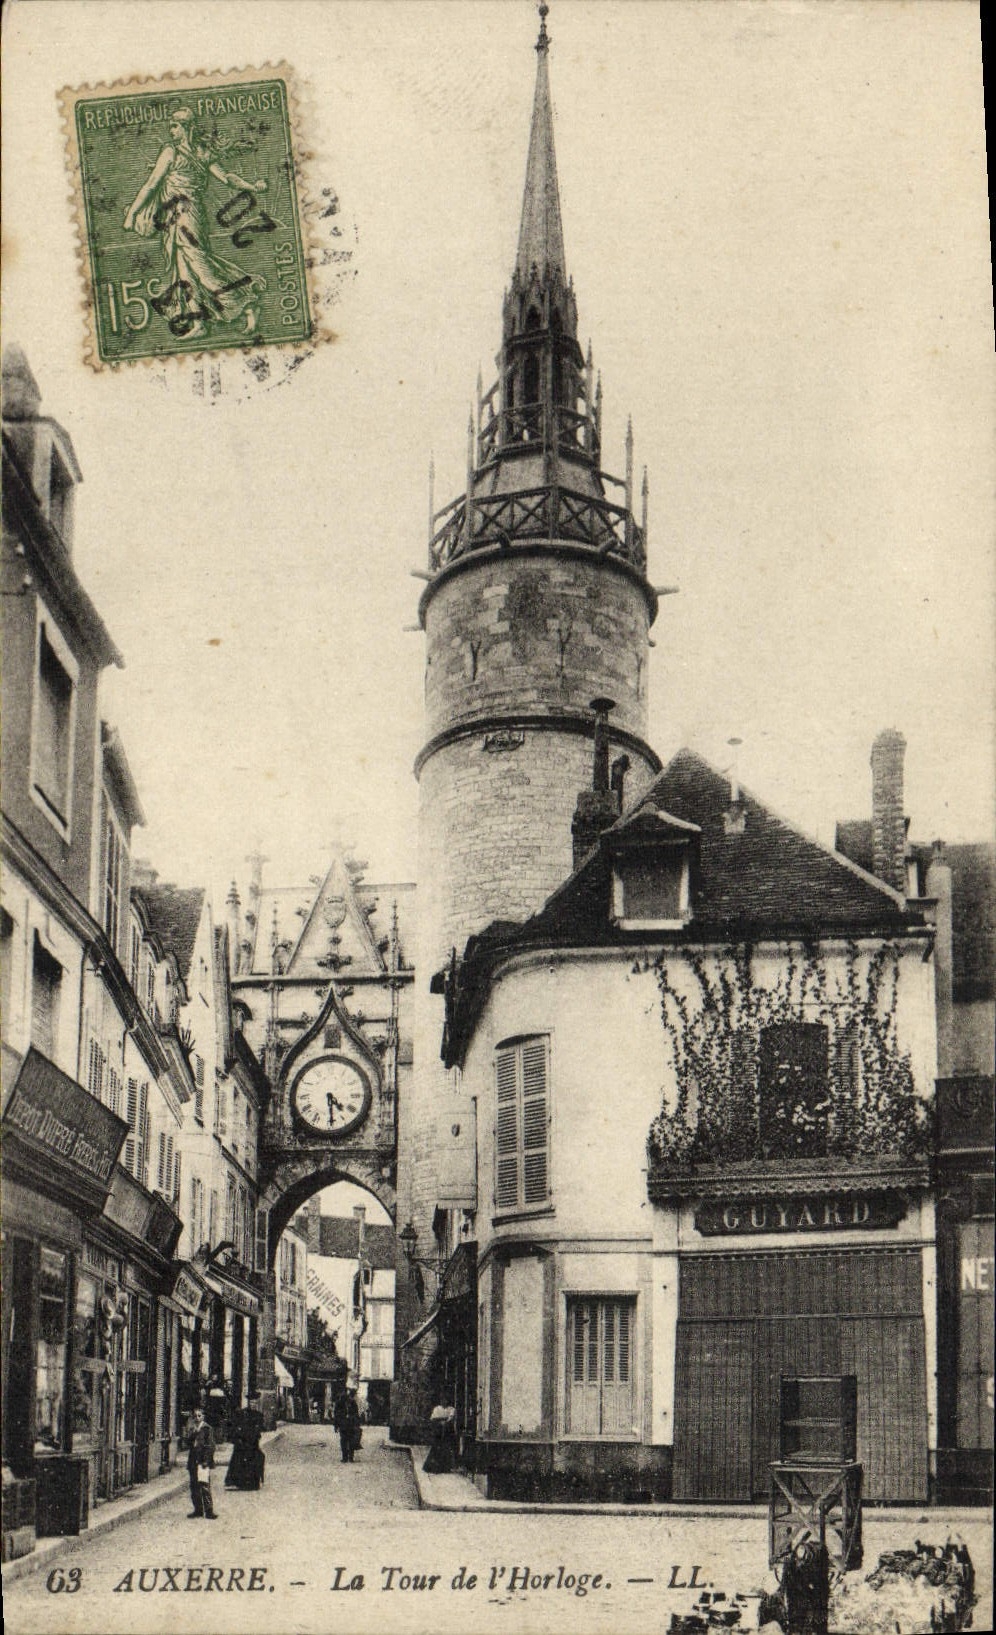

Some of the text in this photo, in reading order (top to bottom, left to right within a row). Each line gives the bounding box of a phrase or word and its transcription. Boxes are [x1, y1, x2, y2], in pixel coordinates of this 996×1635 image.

[197, 92, 279, 116] FRANÇAISE
[275, 241, 298, 326] POSTES
[722, 1202, 871, 1230] GUYARD
